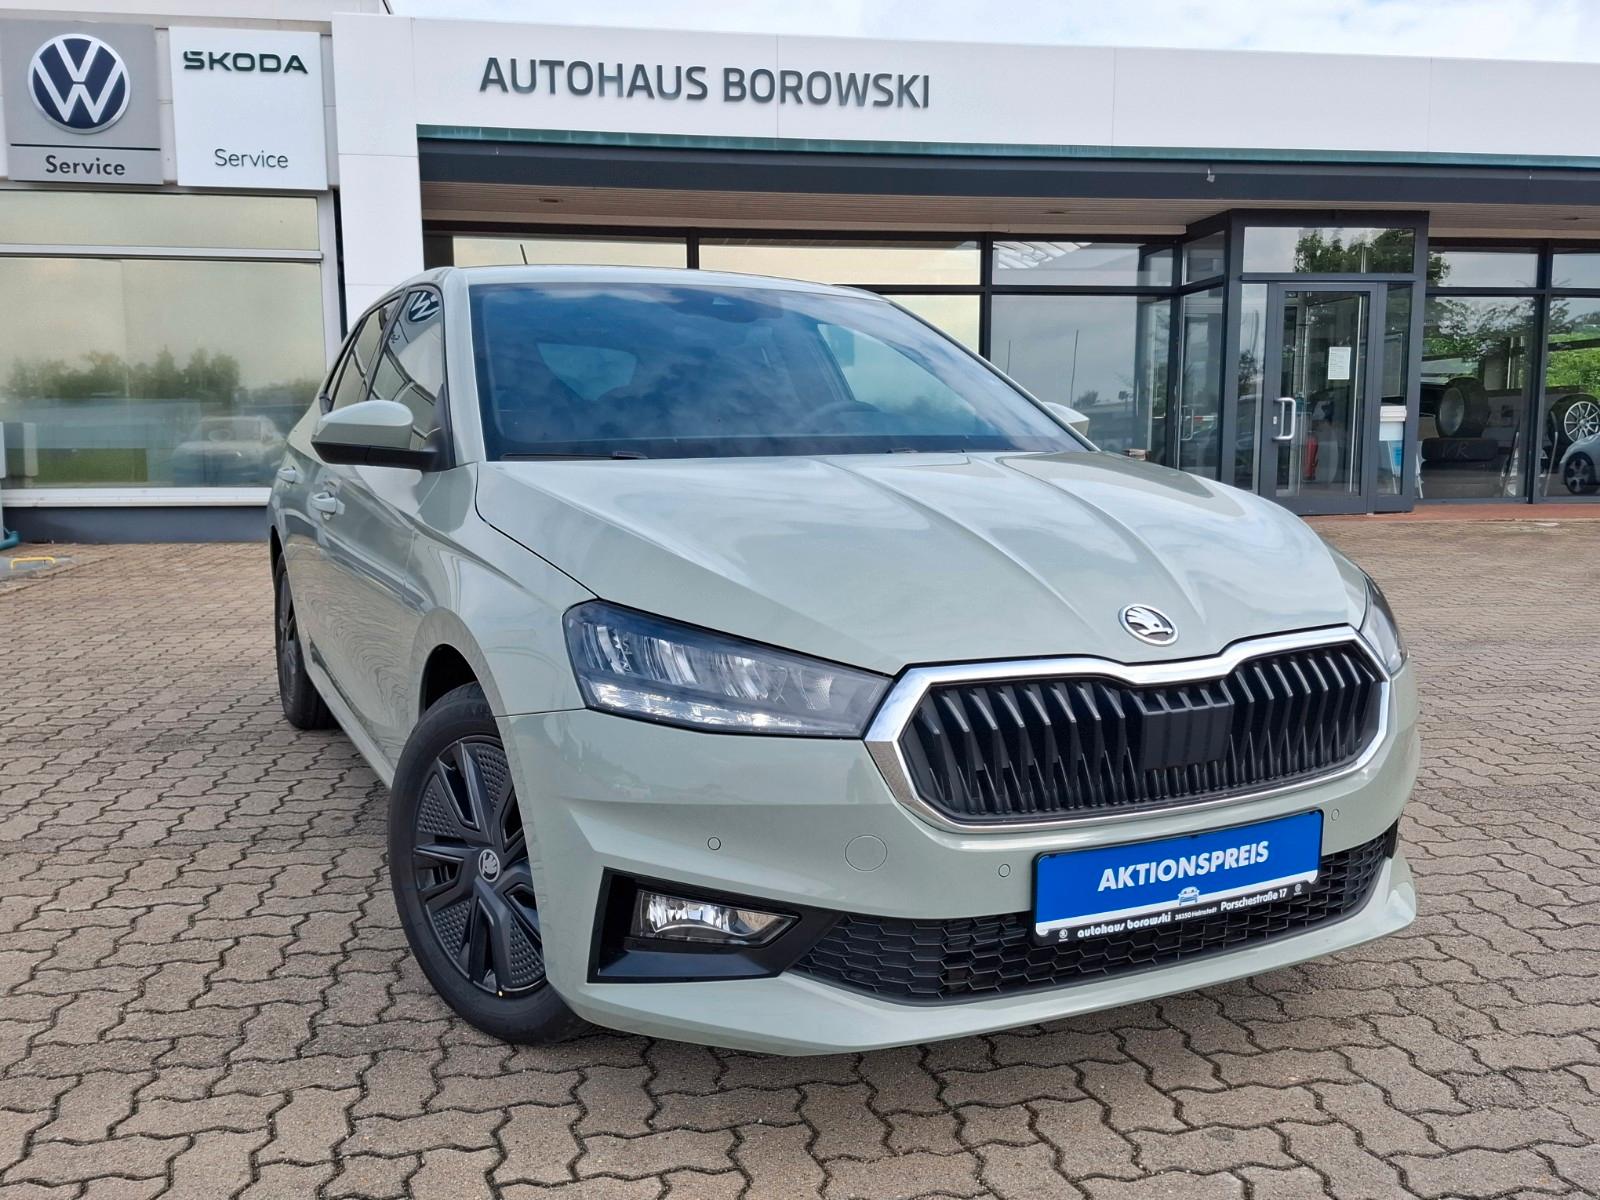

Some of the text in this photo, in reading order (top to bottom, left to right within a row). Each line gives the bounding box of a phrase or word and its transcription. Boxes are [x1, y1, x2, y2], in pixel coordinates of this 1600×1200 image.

[479, 56, 930, 109] AUTOHAUS BOROWSKI
[45, 155, 126, 176] Service
[214, 148, 289, 169] Service
[1097, 841, 1269, 891] AKTIONSPREIS
[1077, 922, 1125, 938] autohaus
[1127, 912, 1171, 929] borowski
[1220, 890, 1278, 911] Porschestraße
[1279, 888, 1288, 898] 17
